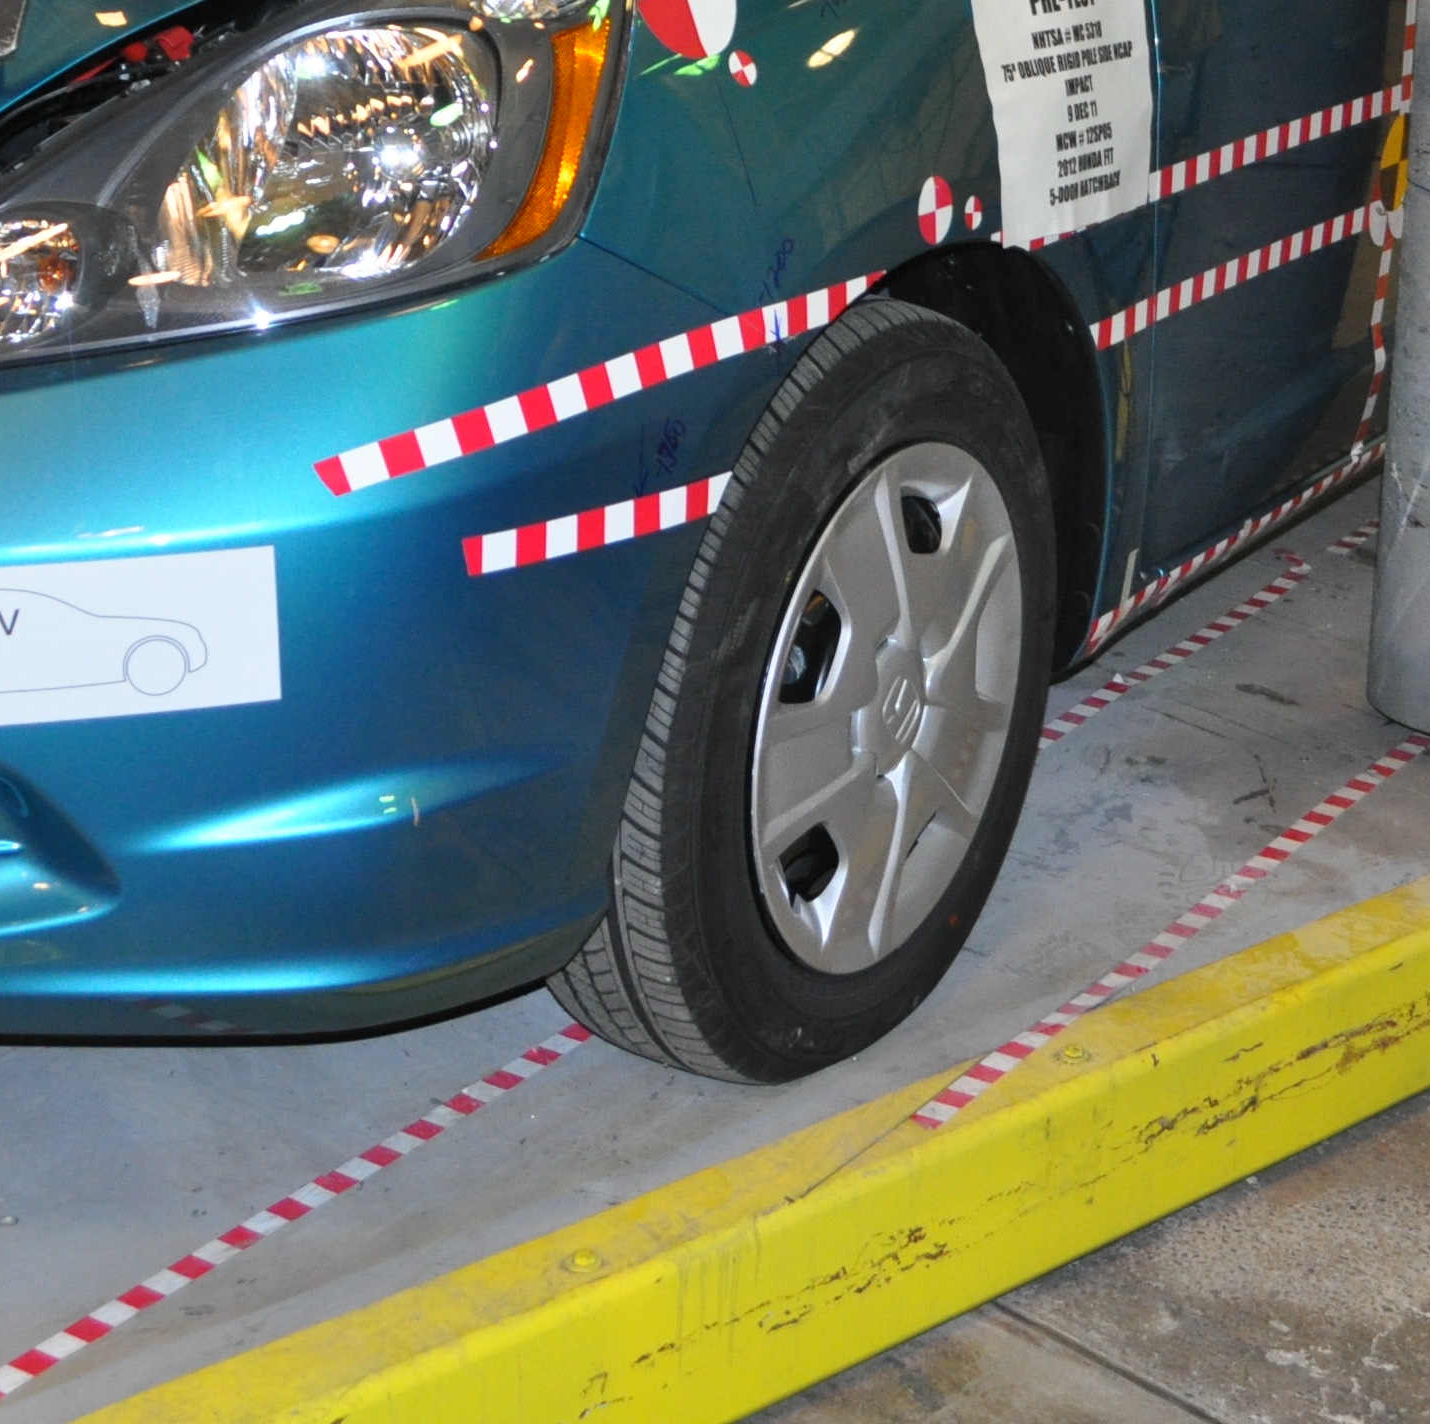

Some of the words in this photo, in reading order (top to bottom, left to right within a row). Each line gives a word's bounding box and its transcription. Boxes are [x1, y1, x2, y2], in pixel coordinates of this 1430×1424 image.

[1031, 27, 1065, 51] NHTSA
[1071, 23, 1086, 43] MC
[1017, 55, 1057, 80] OBLIQUE
[1056, 50, 1081, 72] RIGID
[1080, 46, 1098, 68] POLE
[1097, 43, 1113, 64] SIDE
[1112, 39, 1133, 61] NCAP
[1064, 74, 1094, 97] IMPACT
[1067, 104, 1074, 123] 9
[1073, 100, 1090, 122] DEC
[1089, 99, 1099, 118] 11
[1055, 130, 1078, 153] MCW
[1057, 156, 1078, 179] 2012
[1077, 149, 1103, 173] HONDA
[1102, 146, 1115, 167] FIT
[1049, 181, 1079, 207] 5-DOOR
[1079, 169, 1121, 198] HATCHBACK
